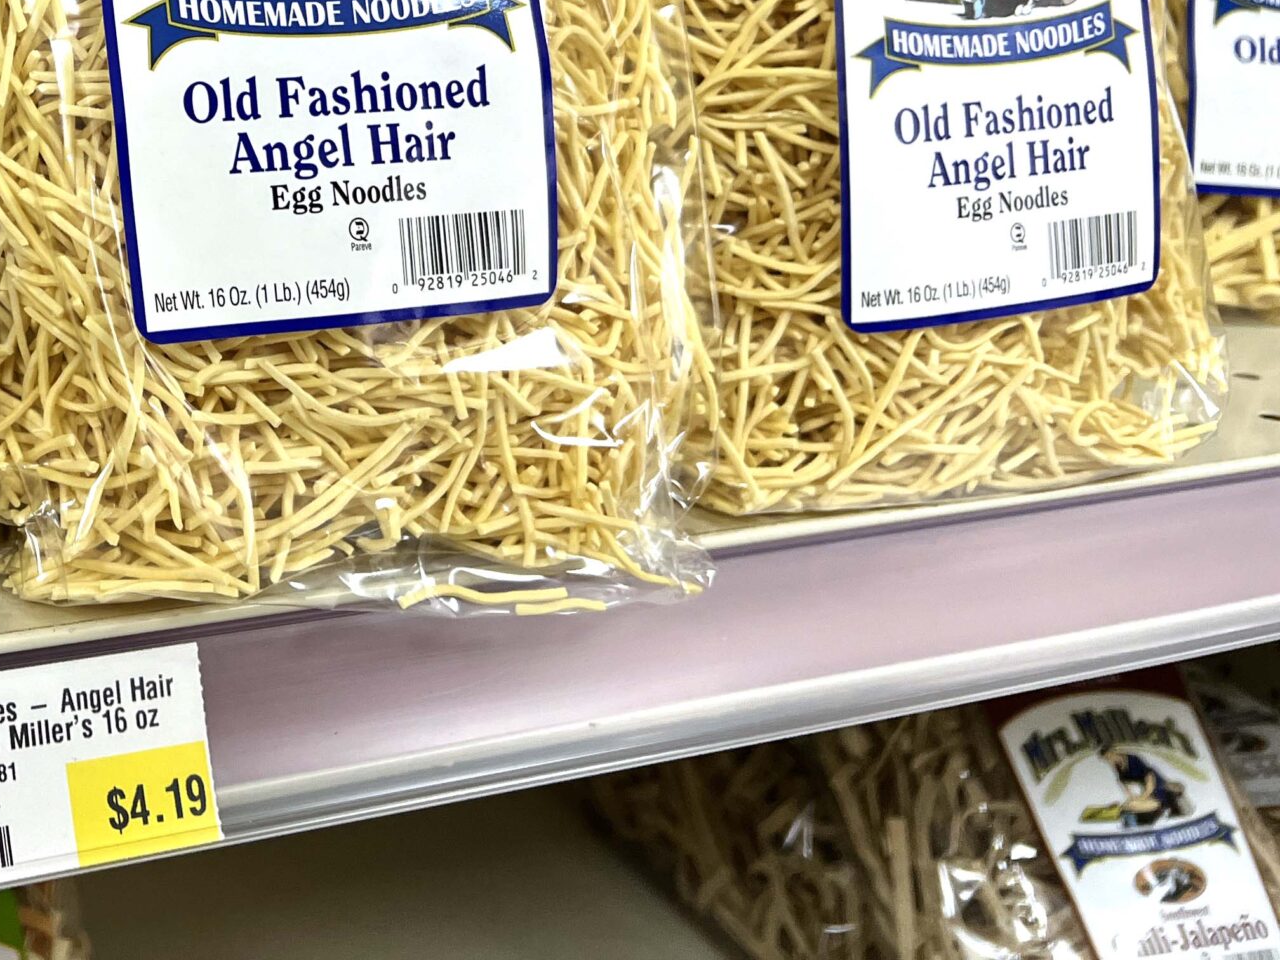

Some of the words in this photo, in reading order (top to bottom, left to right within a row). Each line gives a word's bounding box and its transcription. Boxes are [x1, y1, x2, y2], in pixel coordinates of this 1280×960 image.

[892, 28, 1011, 59] HOMEMADE
[1015, 12, 1107, 47] NOODLES
[182, 75, 261, 125] Old
[276, 64, 490, 119] Fashioned
[894, 100, 951, 146] Old
[962, 86, 1115, 139] Fashioned
[229, 123, 355, 180] Angel
[367, 120, 456, 166] Hair
[928, 142, 1017, 192] Angel
[1026, 136, 1091, 177] Hair
[270, 184, 324, 215] Egg
[331, 175, 428, 207] Noodles
[956, 196, 993, 222] Egg
[999, 185, 1069, 214] Noodles
[154, 291, 178, 313] Net
[180, 288, 205, 310] Wt.
[208, 288, 226, 308] 16
[228, 285, 251, 306] Oz.
[255, 284, 271, 309] (1
[274, 282, 301, 306] Lb.)
[305, 277, 351, 303] (454g)
[392, 283, 399, 295] 0
[417, 275, 464, 291] 92819
[471, 270, 514, 287] 25046
[532, 270, 538, 280] 2
[861, 290, 881, 309] Net
[883, 287, 904, 305] Wt.
[907, 284, 921, 302] 16
[979, 275, 1011, 299] (454g)
[1062, 268, 1094, 284] 92819
[60, 680, 122, 715] Angel
[130, 674, 174, 702] Hair
[9, 716, 93, 751] Miller's
[102, 707, 127, 735] 16
[136, 708, 159, 730] oz
[106, 773, 207, 835] $4.19
